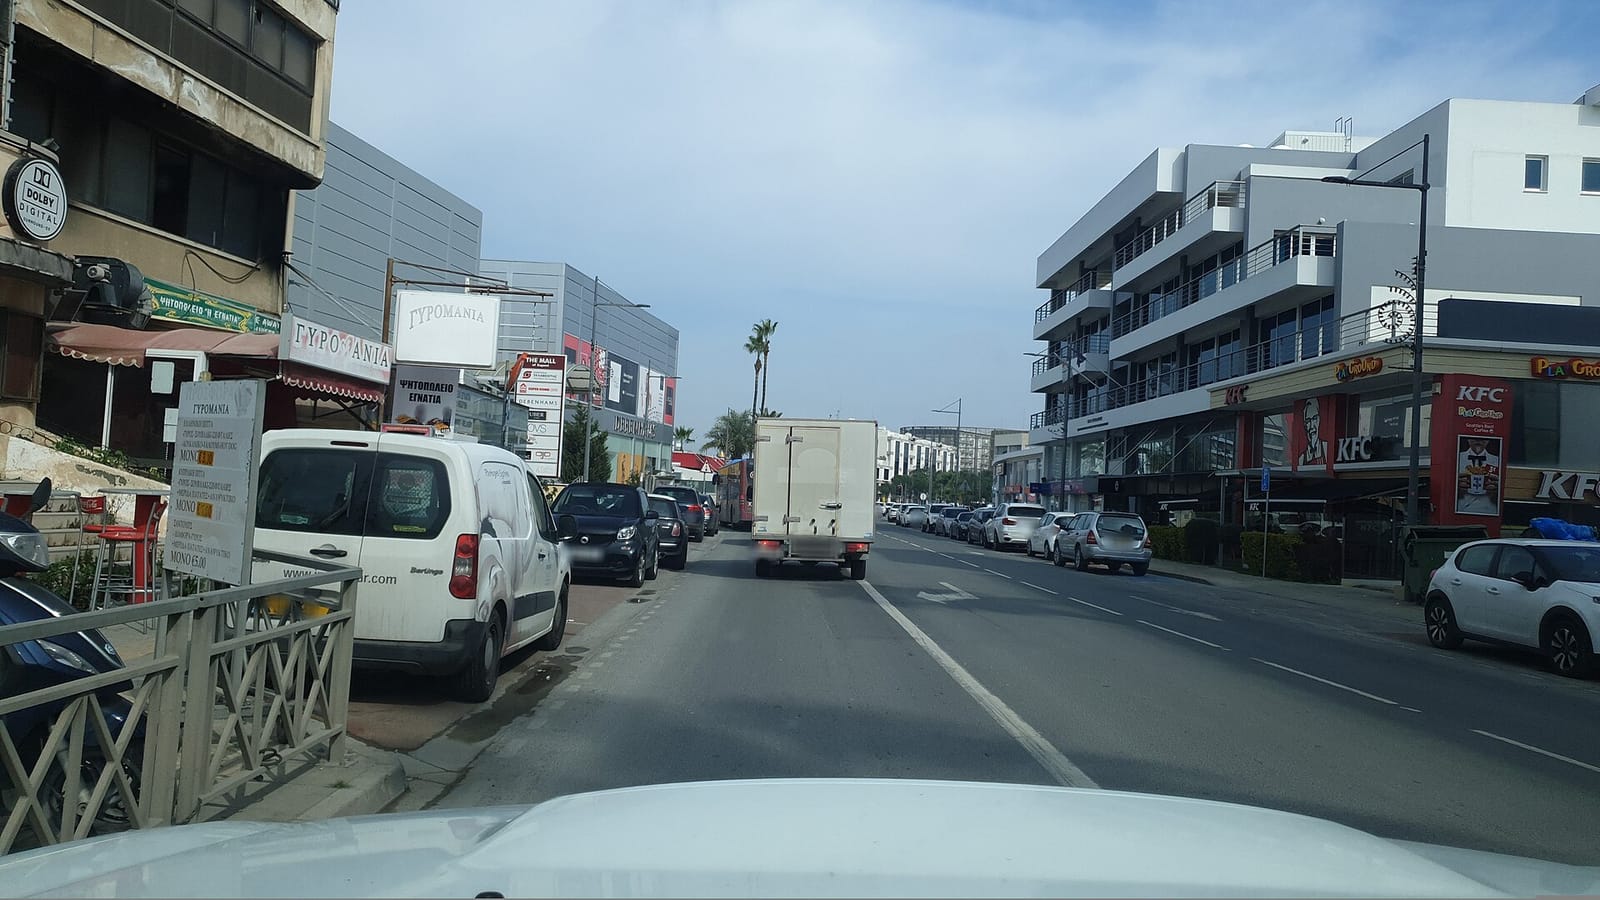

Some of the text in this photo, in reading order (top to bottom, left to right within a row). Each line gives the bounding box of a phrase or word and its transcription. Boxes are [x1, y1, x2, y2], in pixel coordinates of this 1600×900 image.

[27, 188, 54, 207] DOLBY
[20, 202, 58, 225] DIGITAL
[408, 303, 485, 330] ΓΥΡΟΜΑΝΙΑ
[295, 323, 389, 368] ΓΥΡΟΑΝΙΑ
[539, 357, 556, 365] MALL
[400, 380, 454, 393] ΨΗΤΟΠΩΛΕΙΟ
[1224, 384, 1250, 406] KFC
[1456, 386, 1504, 403] KFC
[409, 392, 441, 404] ΕΓΝΑΤΙΑ
[193, 403, 230, 415] ΓΥΡΟΜΑΝΙΑ
[527, 423, 547, 433] OVS
[1336, 435, 1373, 463] KFC
[1535, 471, 1600, 501] KF
